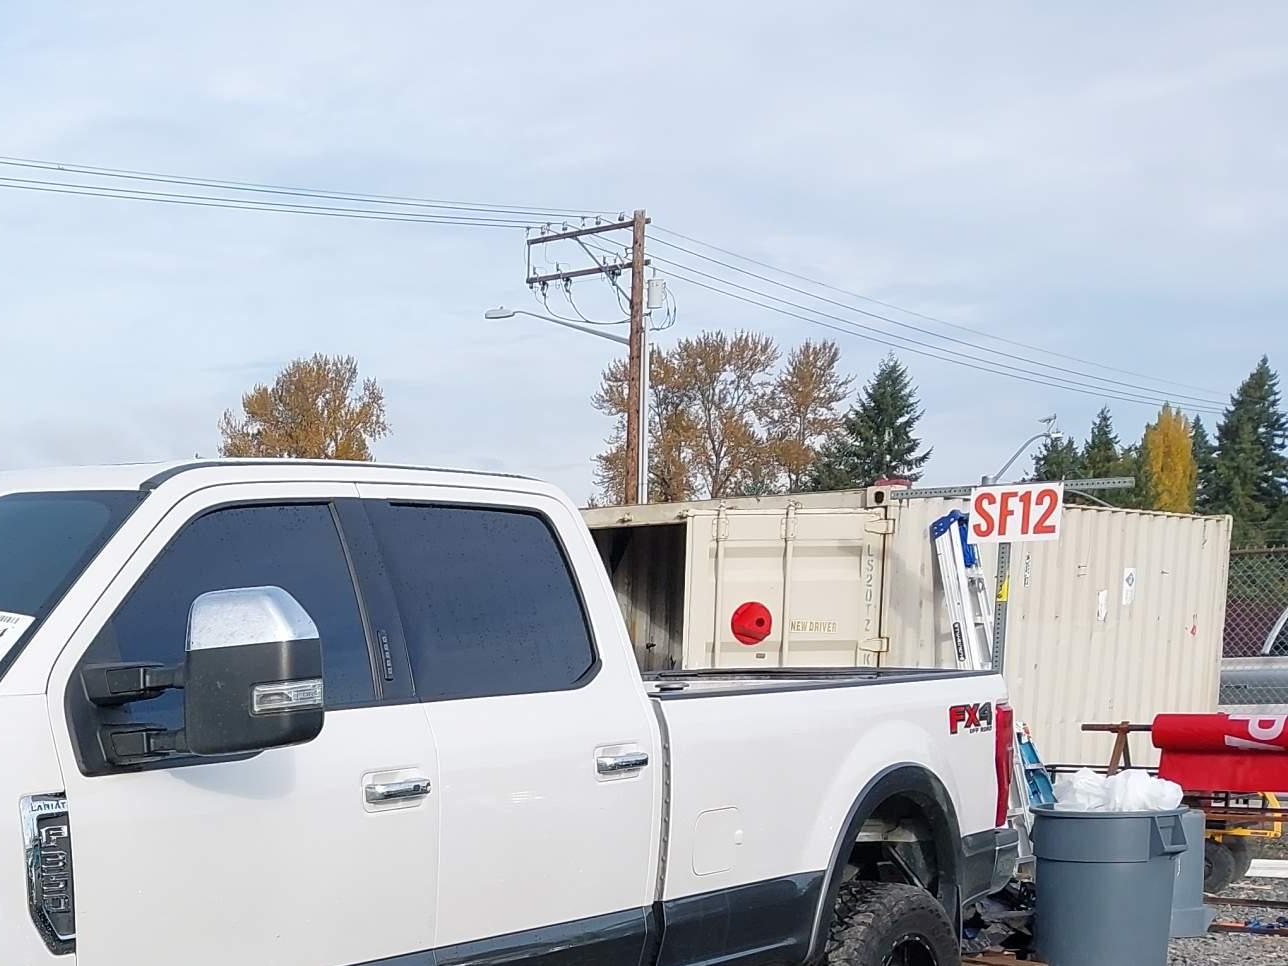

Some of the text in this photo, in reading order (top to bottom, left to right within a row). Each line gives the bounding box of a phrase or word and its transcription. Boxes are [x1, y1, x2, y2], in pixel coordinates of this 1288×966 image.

[972, 488, 1059, 538] SF12
[790, 620, 808, 632] NEW
[949, 701, 993, 735] FX4
[30, 801, 66, 812] LARIAT
